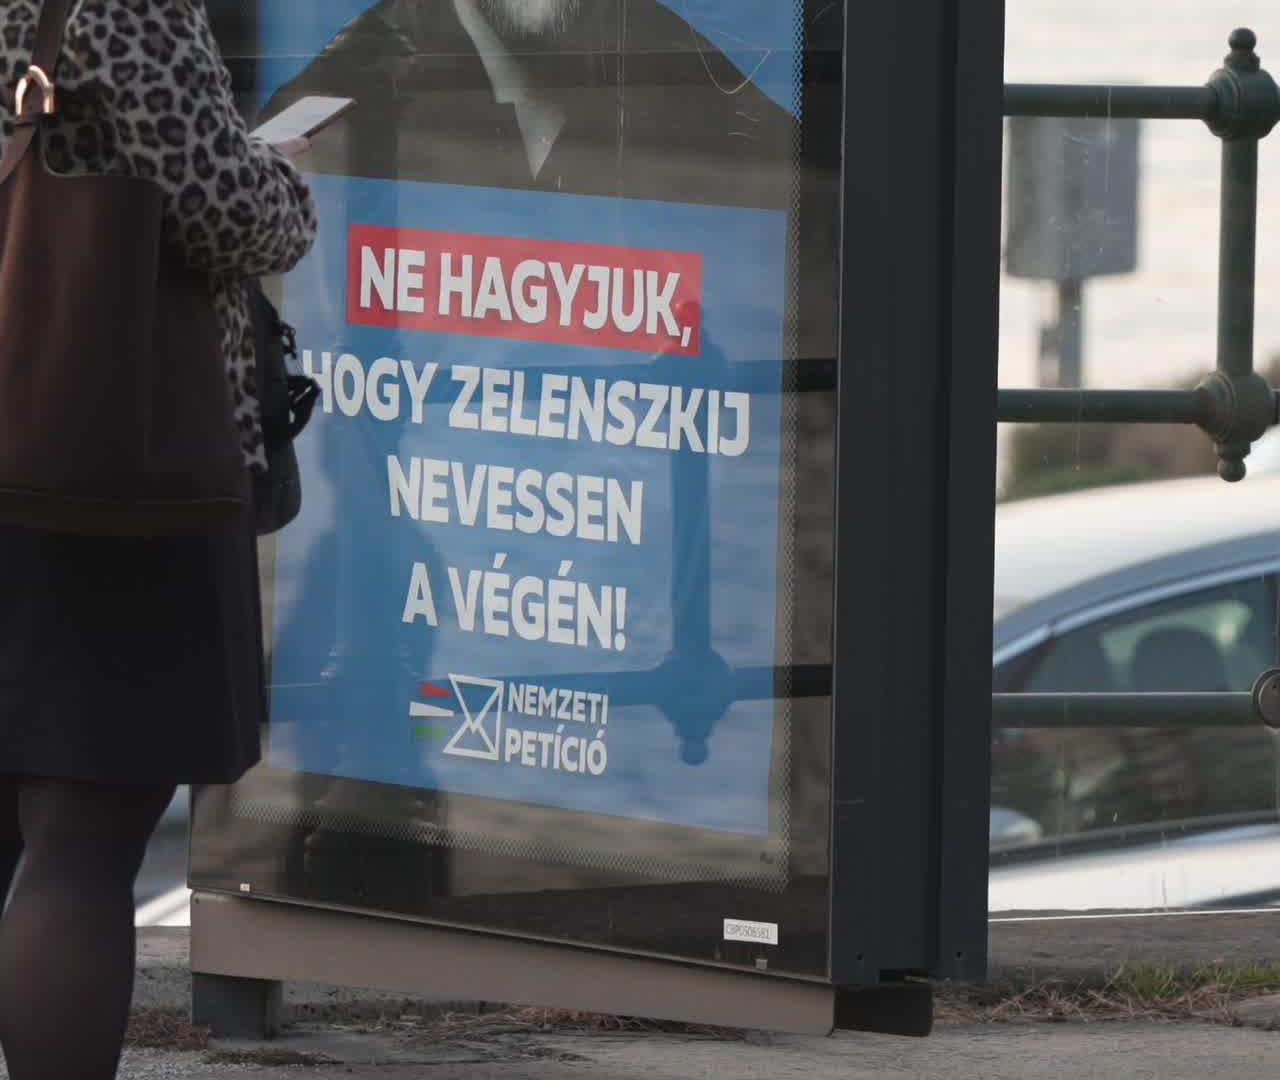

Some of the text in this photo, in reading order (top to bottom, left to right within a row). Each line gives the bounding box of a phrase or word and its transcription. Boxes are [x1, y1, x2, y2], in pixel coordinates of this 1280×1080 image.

[359, 245, 693, 347] NE HAGYJUK,
[302, 349, 751, 457] HOGY ZELENSZKIJ
[387, 454, 644, 545] NEVESSEN
[401, 552, 628, 652] A VÉGÉN!
[505, 726, 608, 775] PETÍCIÓ
[506, 682, 609, 725] NEMZETI
